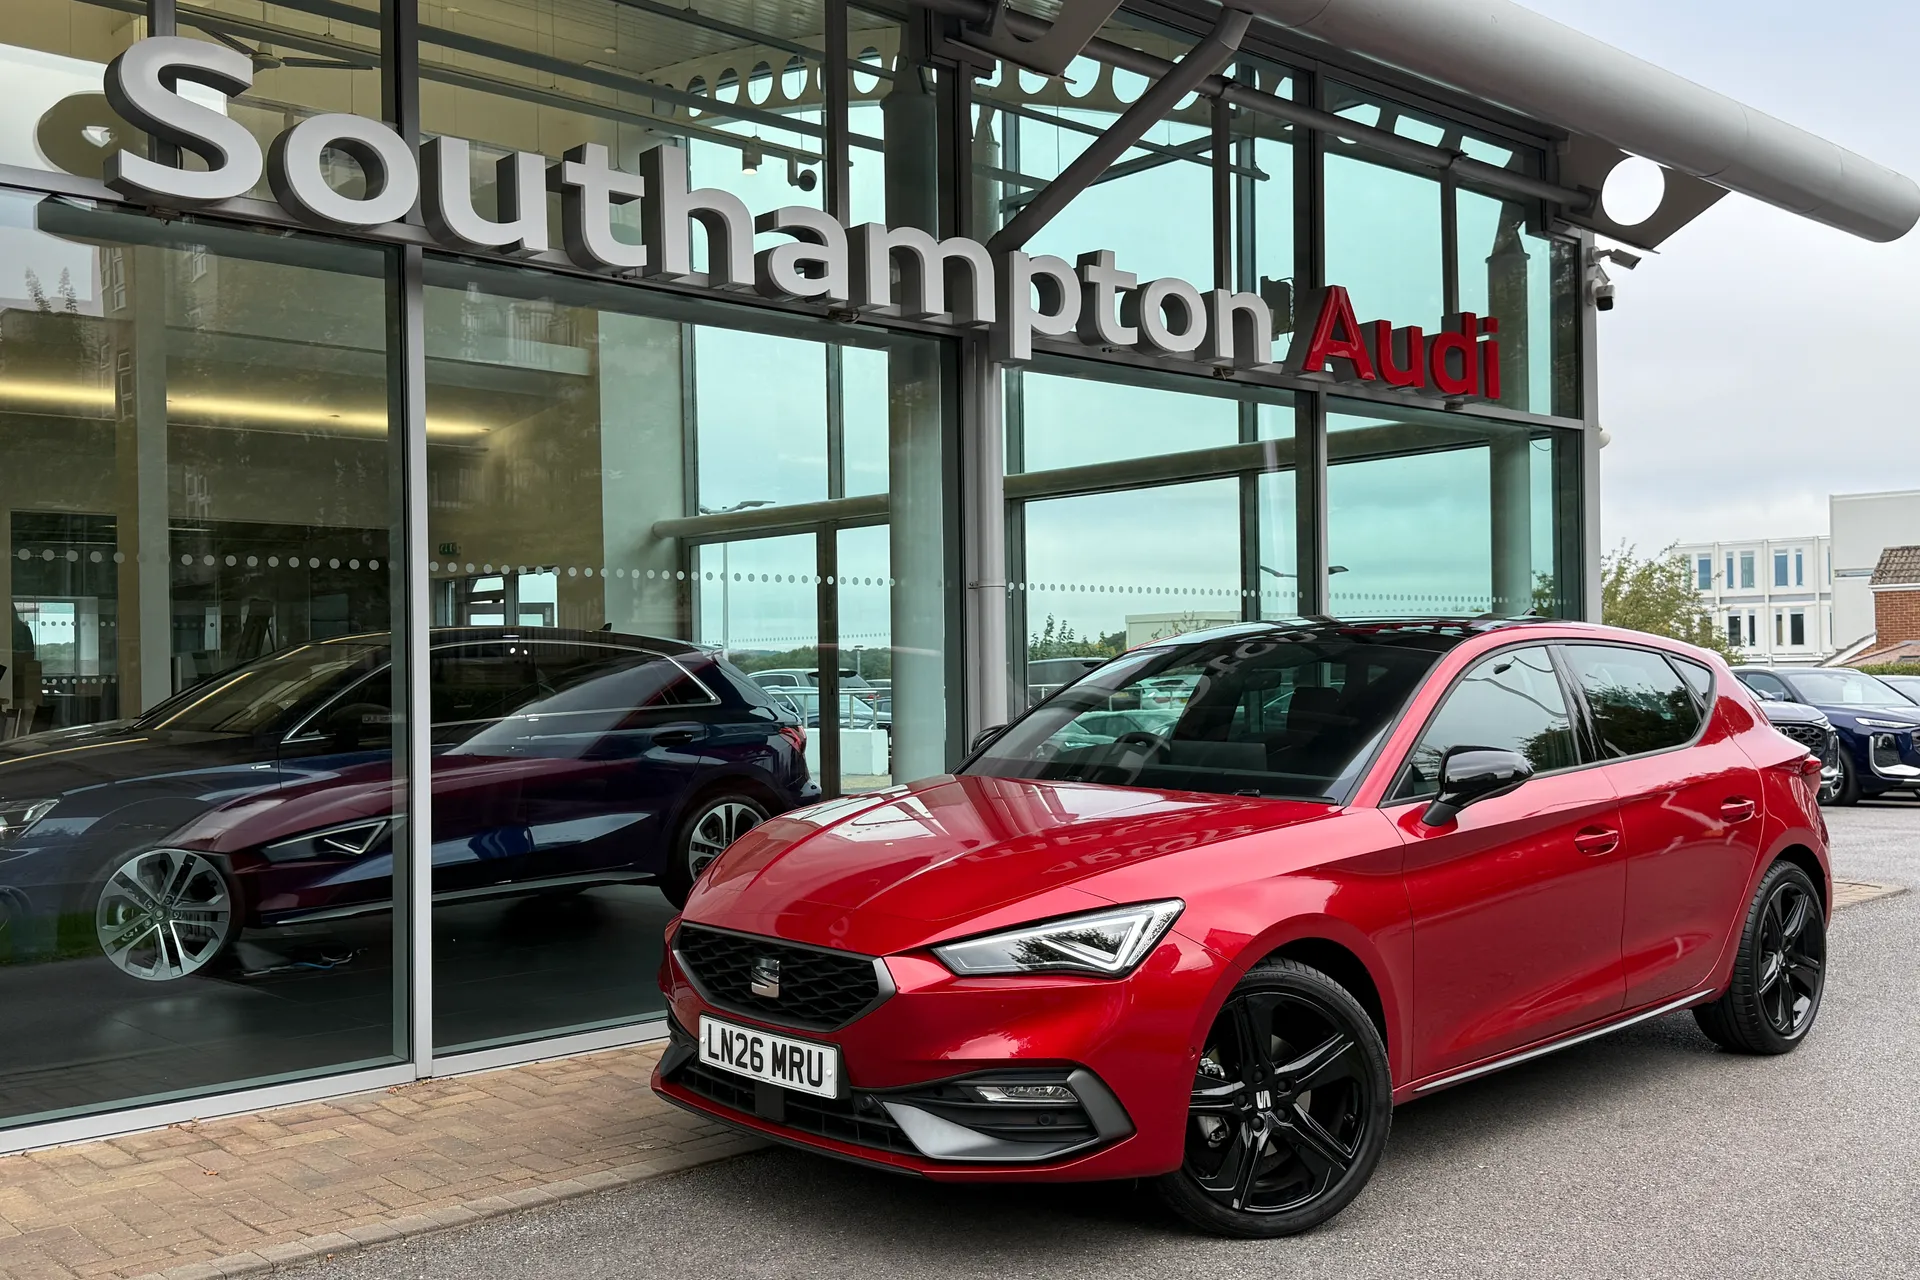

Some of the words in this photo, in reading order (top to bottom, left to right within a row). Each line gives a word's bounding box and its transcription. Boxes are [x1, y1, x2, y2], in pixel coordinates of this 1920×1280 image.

[104, 35, 1272, 361] Southampton
[1303, 285, 1500, 399] Audi
[707, 1023, 764, 1073] LN26
[772, 1041, 823, 1087] MRU
